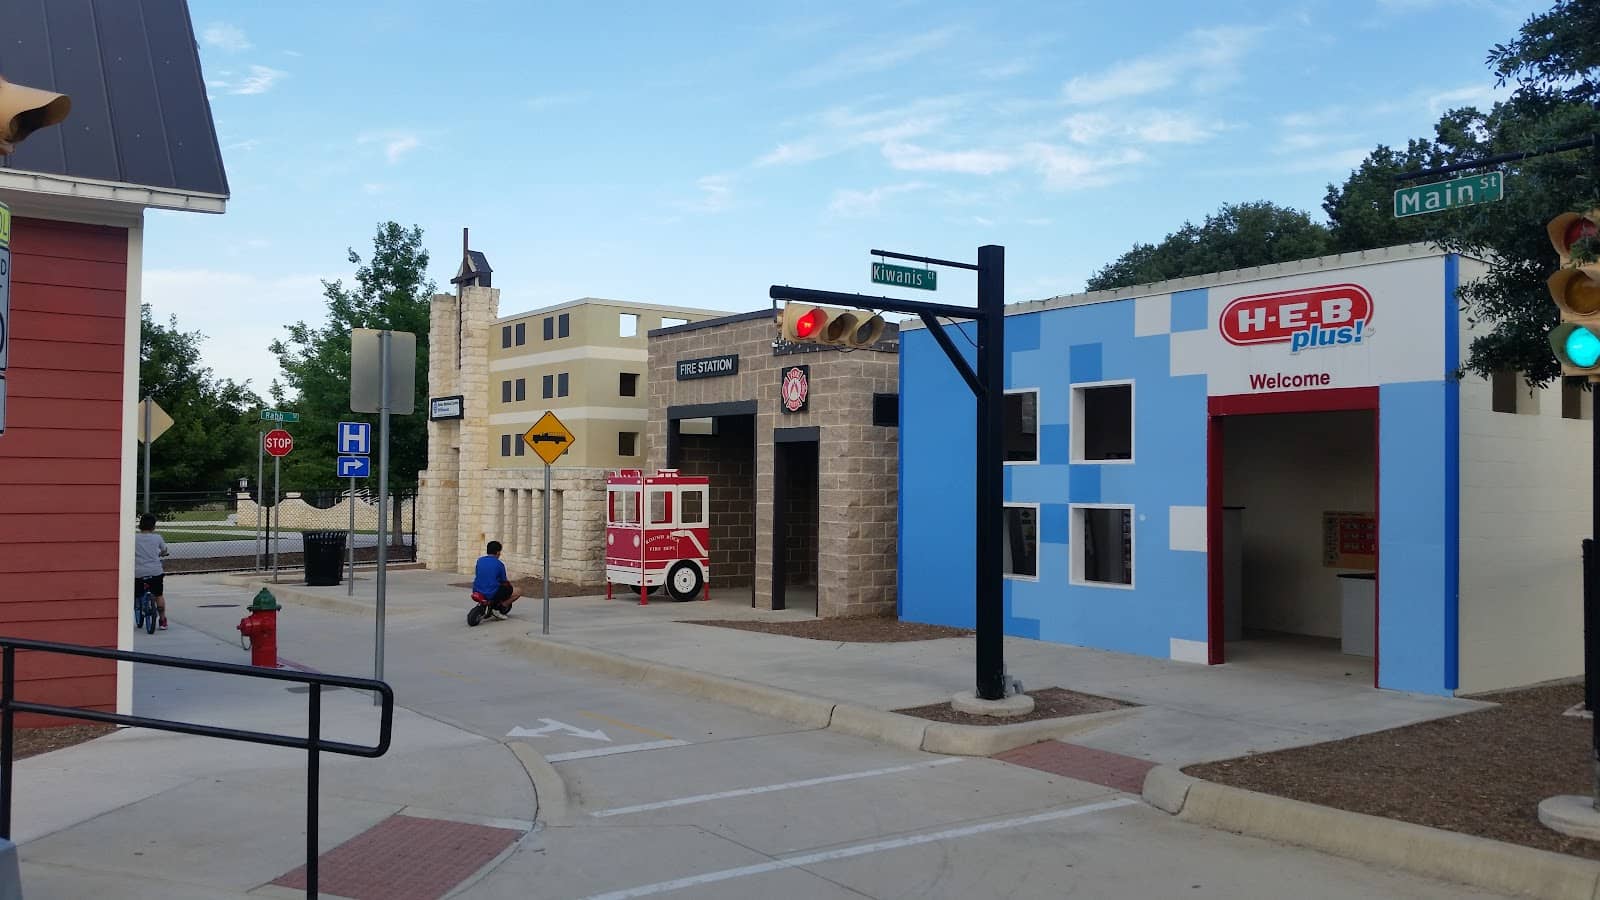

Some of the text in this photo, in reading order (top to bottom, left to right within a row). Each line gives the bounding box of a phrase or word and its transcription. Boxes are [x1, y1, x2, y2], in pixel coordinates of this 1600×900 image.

[1401, 175, 1497, 214] Main St
[873, 264, 923, 286] Kiwanis
[1291, 320, 1365, 353] plus!
[680, 358, 733, 376] FIRE STATION
[1250, 372, 1331, 390] Welcome
[266, 437, 292, 449] STOP
[342, 424, 366, 452] H
